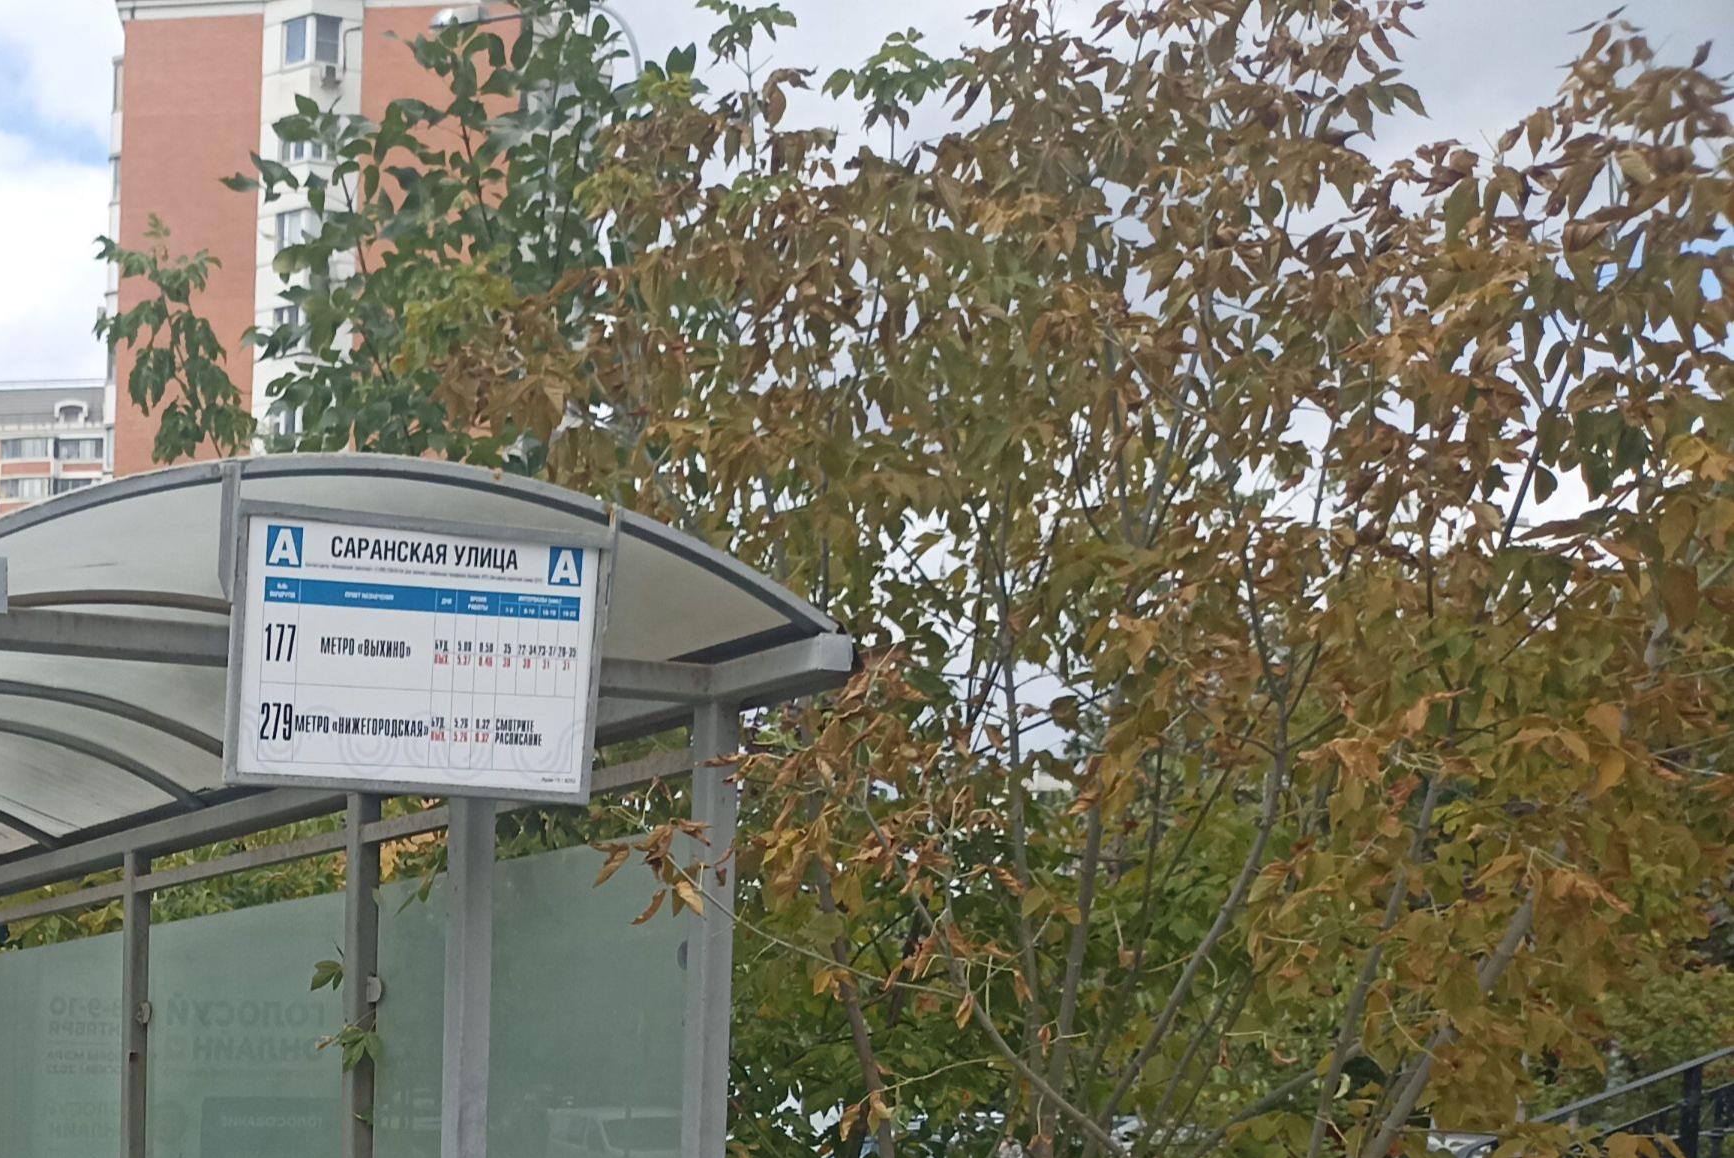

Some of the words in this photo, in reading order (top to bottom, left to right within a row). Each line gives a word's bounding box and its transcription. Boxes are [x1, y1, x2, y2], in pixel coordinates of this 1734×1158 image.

[331, 535, 447, 565] САРАНСКАЯ
[454, 545, 518, 574] УЛИЦА
[265, 623, 296, 662] 177
[321, 637, 354, 655] МЕТРО
[358, 639, 411, 658] «ВЫХИНО»
[260, 703, 292, 741] 279
[295, 715, 329, 733] МЕТРО
[332, 717, 429, 738] «НИЖЕГОРОДСКАЯ»
